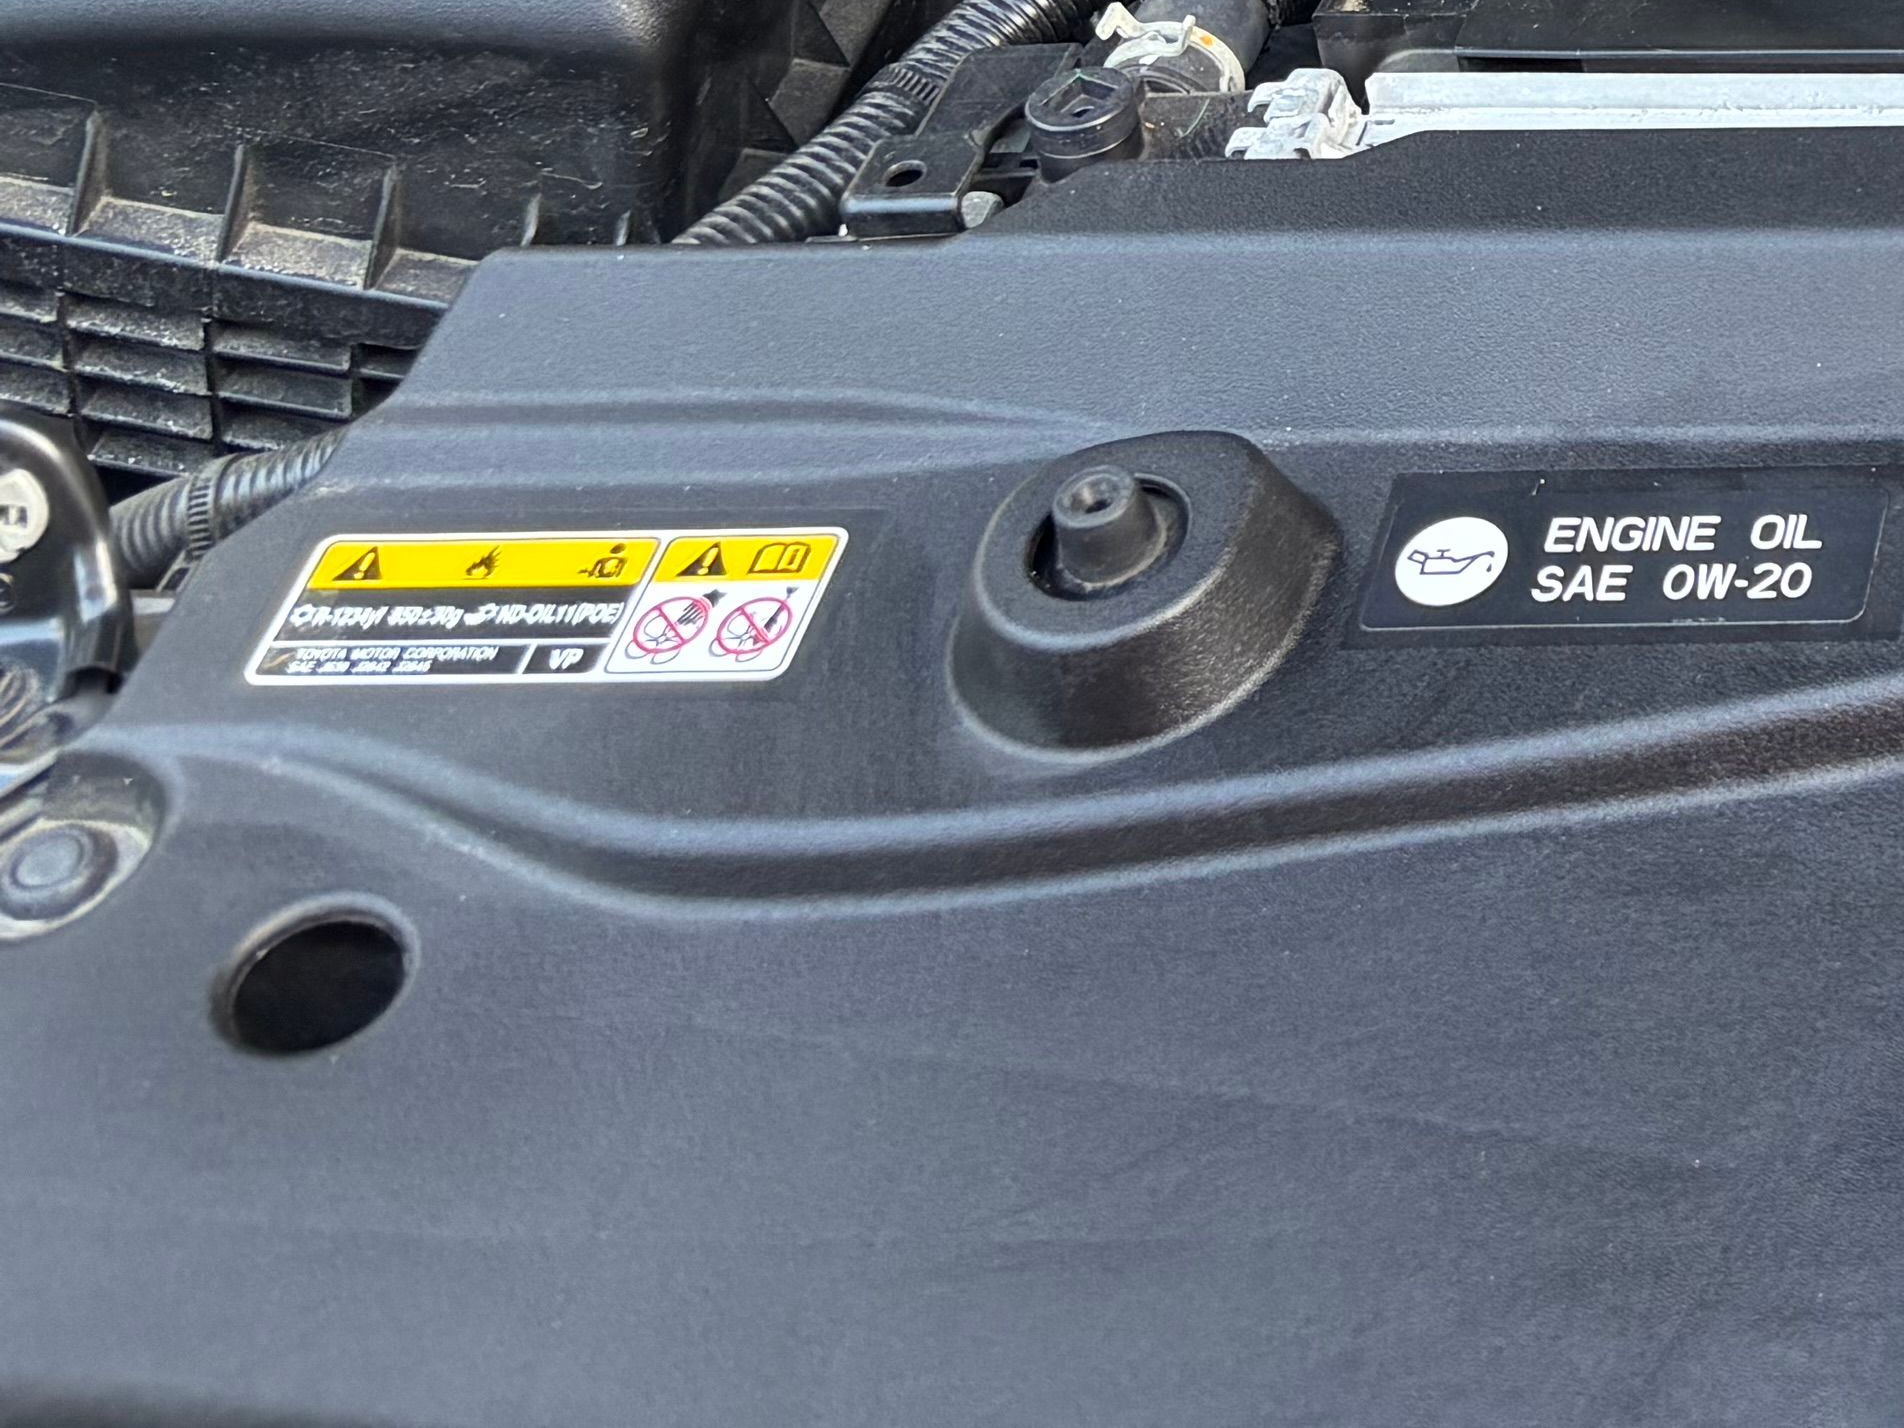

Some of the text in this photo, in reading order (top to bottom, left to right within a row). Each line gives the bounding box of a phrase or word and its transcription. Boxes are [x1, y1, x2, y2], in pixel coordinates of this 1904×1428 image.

[1542, 512, 1823, 554] ENGINE OIL
[1529, 561, 1813, 604] SAE 0W-20
[312, 606, 389, 631] R-1234yf
[286, 660, 317, 674] SAE
[296, 645, 585, 671] TOYOTA MOTOR CORPORATION VP
